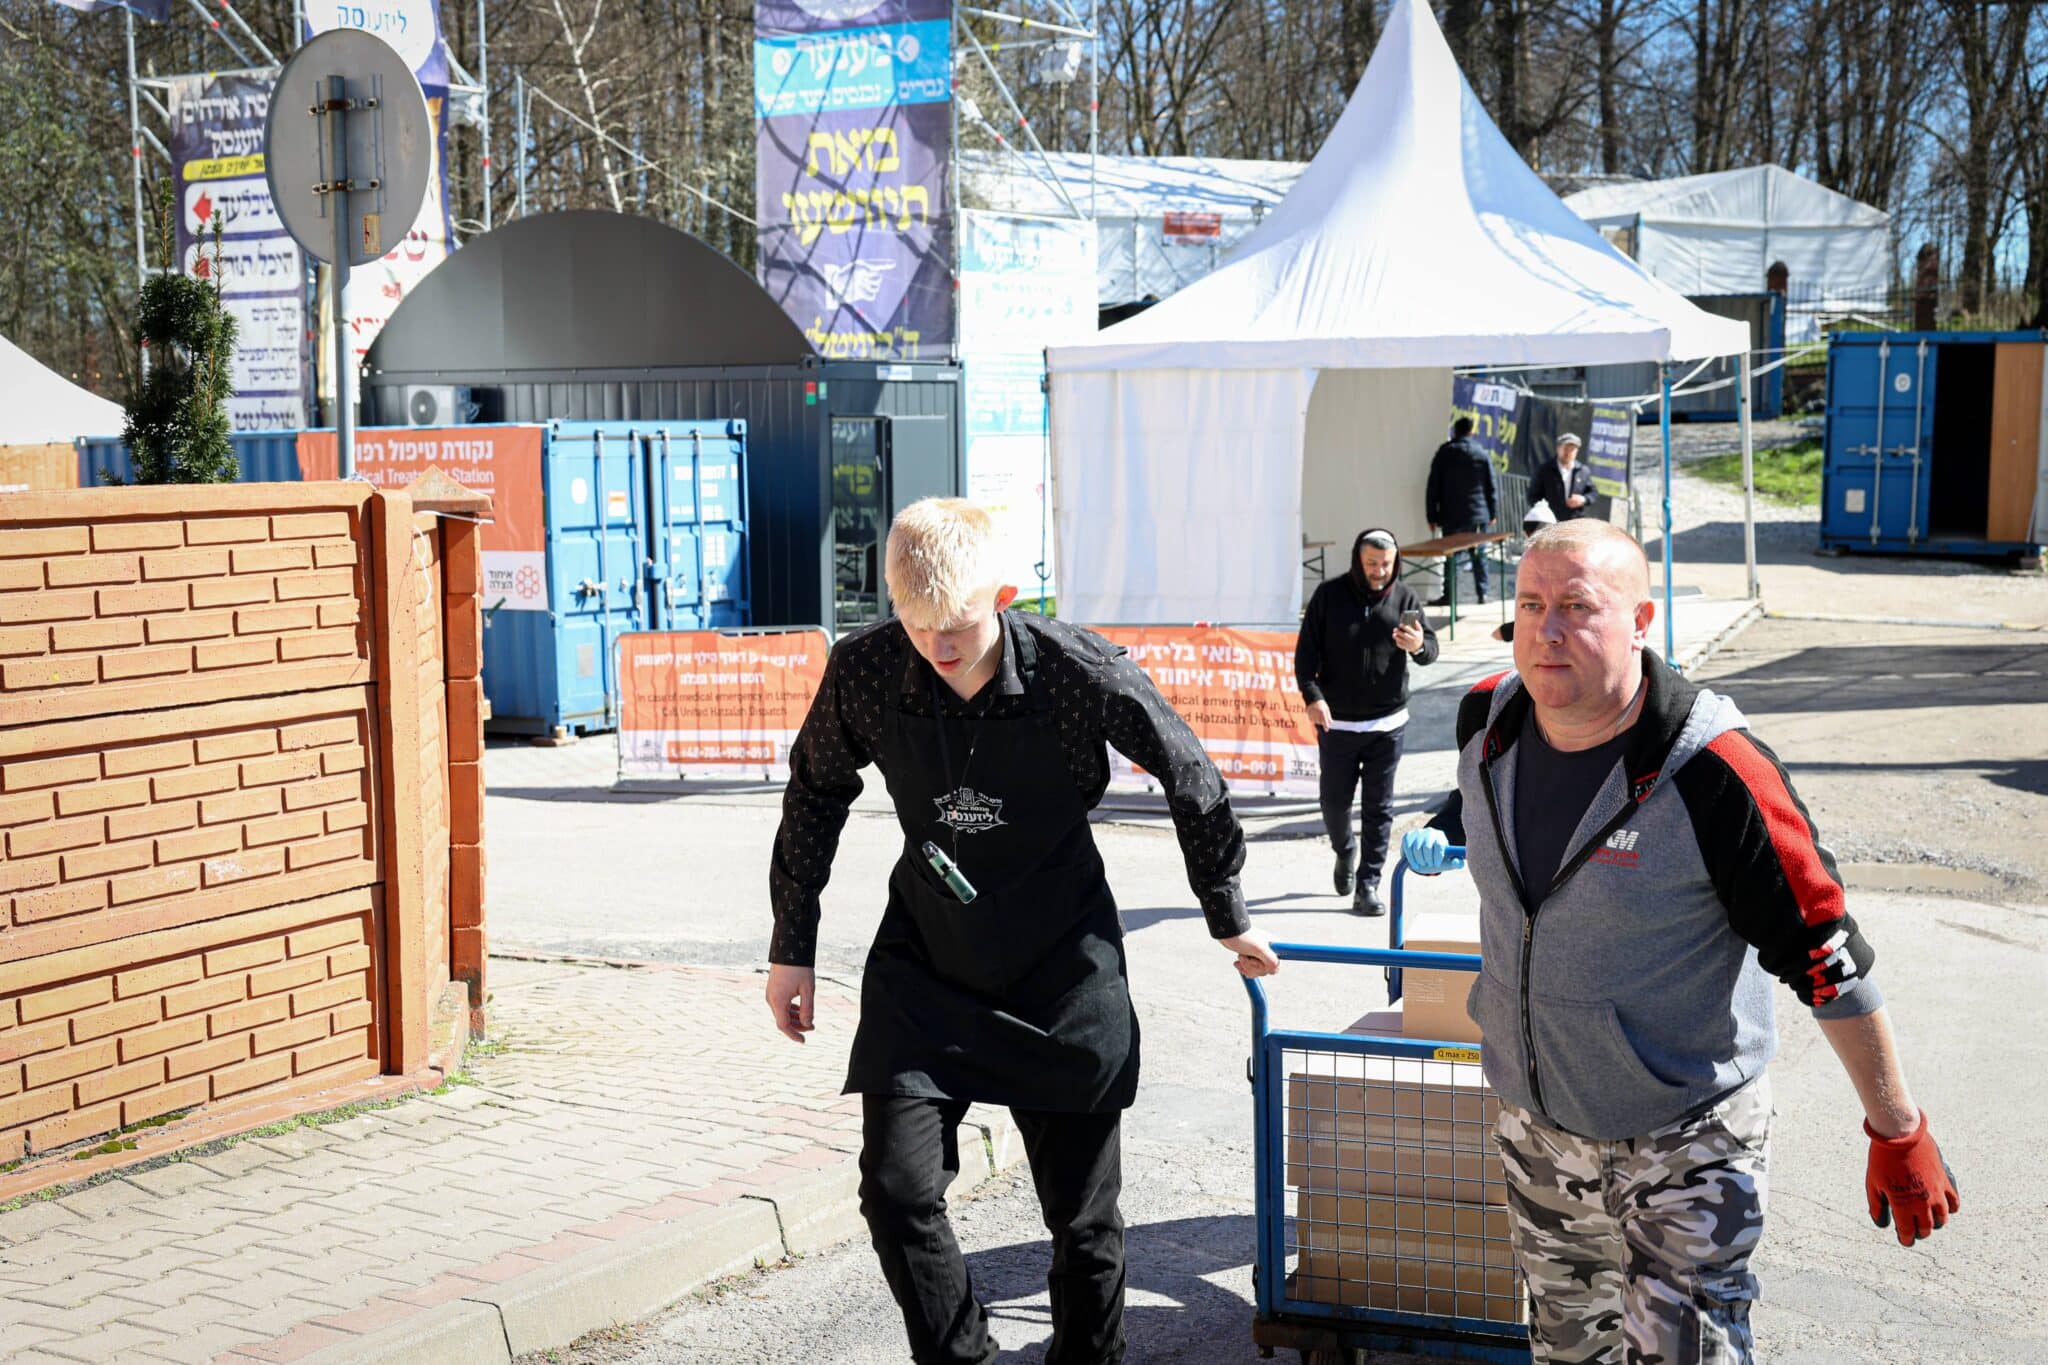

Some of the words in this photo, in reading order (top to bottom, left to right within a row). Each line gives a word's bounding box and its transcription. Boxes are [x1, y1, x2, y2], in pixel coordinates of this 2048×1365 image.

[388, 438, 438, 462] טיפול
[442, 440, 494, 464] נקודת
[451, 467, 494, 484] Station
[1203, 645, 1254, 665] רפואי
[1157, 667, 1212, 686] איחוד
[1219, 668, 1275, 691] למוקד
[679, 691, 713, 702] medical
[1203, 696, 1266, 712] emergency
[1195, 712, 1247, 726] Hatzalah
